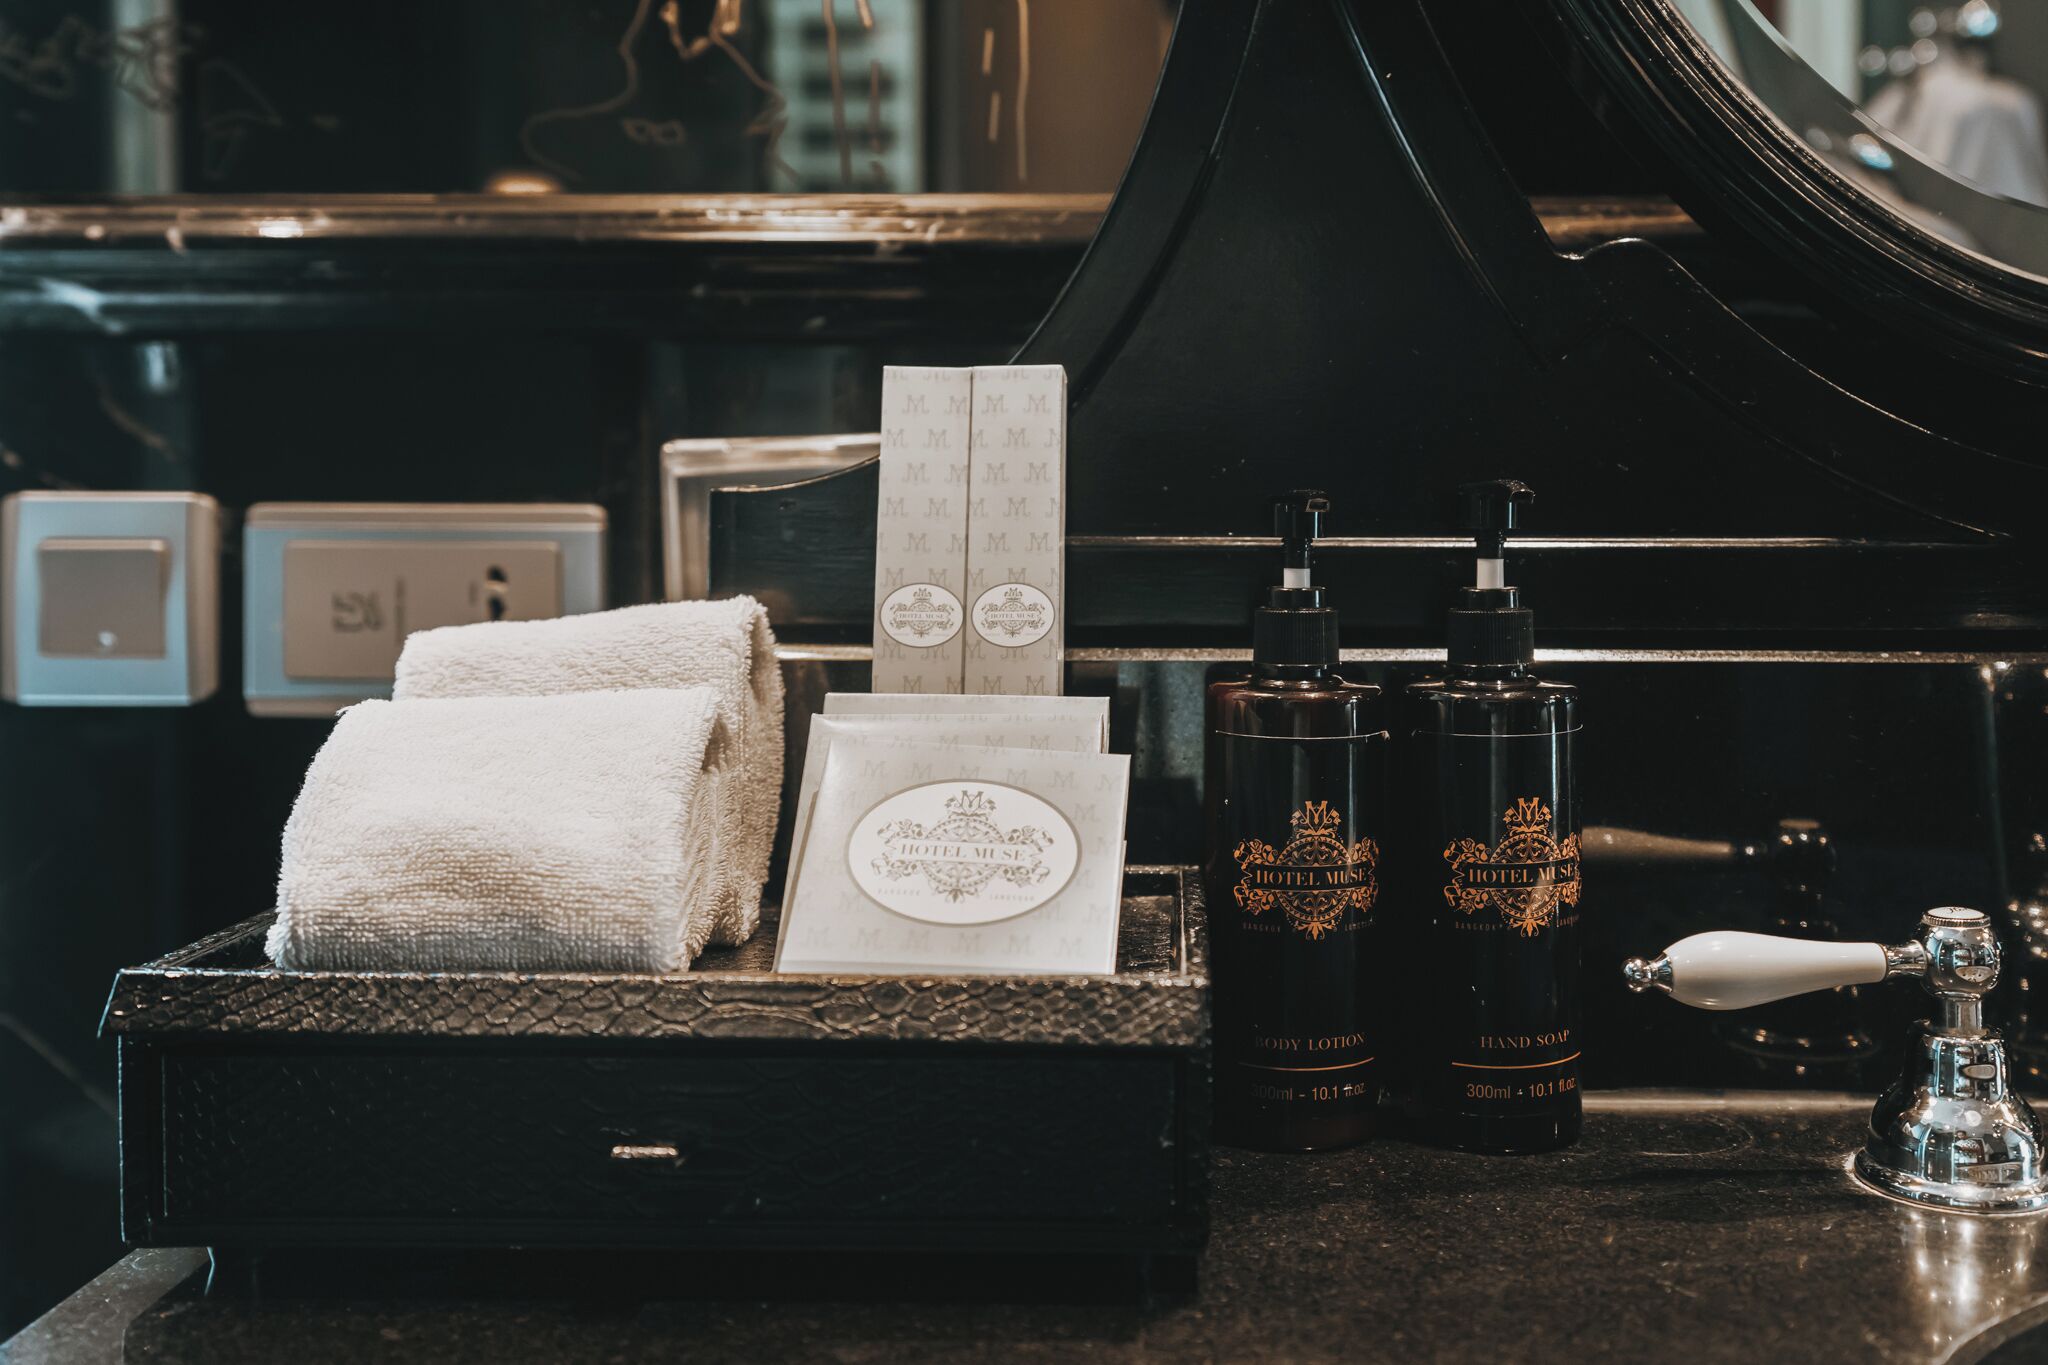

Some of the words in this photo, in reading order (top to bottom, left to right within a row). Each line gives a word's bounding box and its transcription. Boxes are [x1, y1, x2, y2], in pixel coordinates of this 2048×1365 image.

[901, 843, 967, 858] HOTEL
[974, 847, 1027, 861] MUSE
[1255, 869, 1321, 886] HOTEL
[1326, 867, 1368, 885] MUSE
[1468, 867, 1534, 884] HOTEL
[1538, 862, 1575, 882] MUSE
[1255, 1036, 1300, 1051] BODY
[1308, 1033, 1367, 1051] LOTION
[1480, 1036, 1531, 1049] HAND
[1536, 1028, 1571, 1047] SOAP
[1252, 1085, 1293, 1101] 300ml
[1311, 1085, 1339, 1101] 10.1
[1466, 1083, 1511, 1099] 300ml
[1528, 1081, 1554, 1098] 10.1
